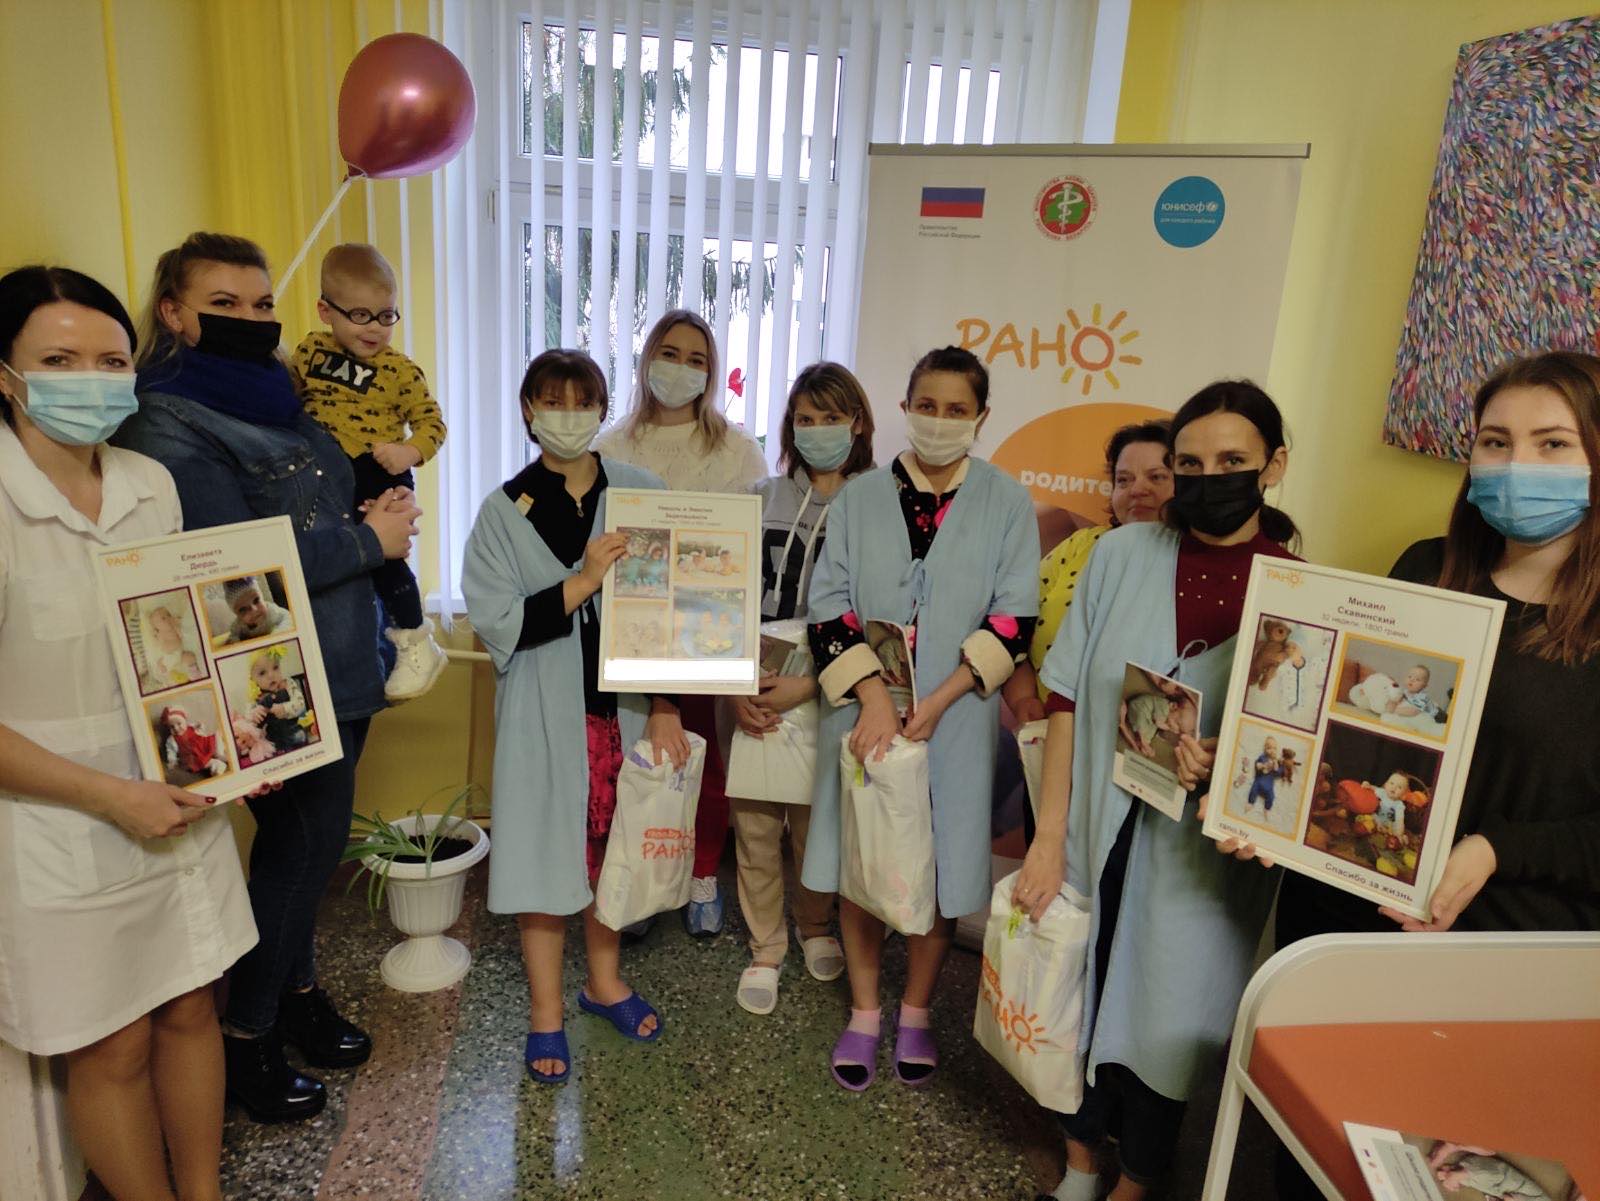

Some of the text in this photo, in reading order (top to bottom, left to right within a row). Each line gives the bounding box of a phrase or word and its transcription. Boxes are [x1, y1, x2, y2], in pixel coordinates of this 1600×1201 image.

[310, 351, 373, 386] PLAY
[180, 549, 222, 561] Елизавета
[1348, 596, 1386, 612] Михаил
[1337, 606, 1396, 626] Скавинский
[1384, 626, 1409, 639] грамм
[1325, 862, 1413, 903] Спасибо за жизнь
